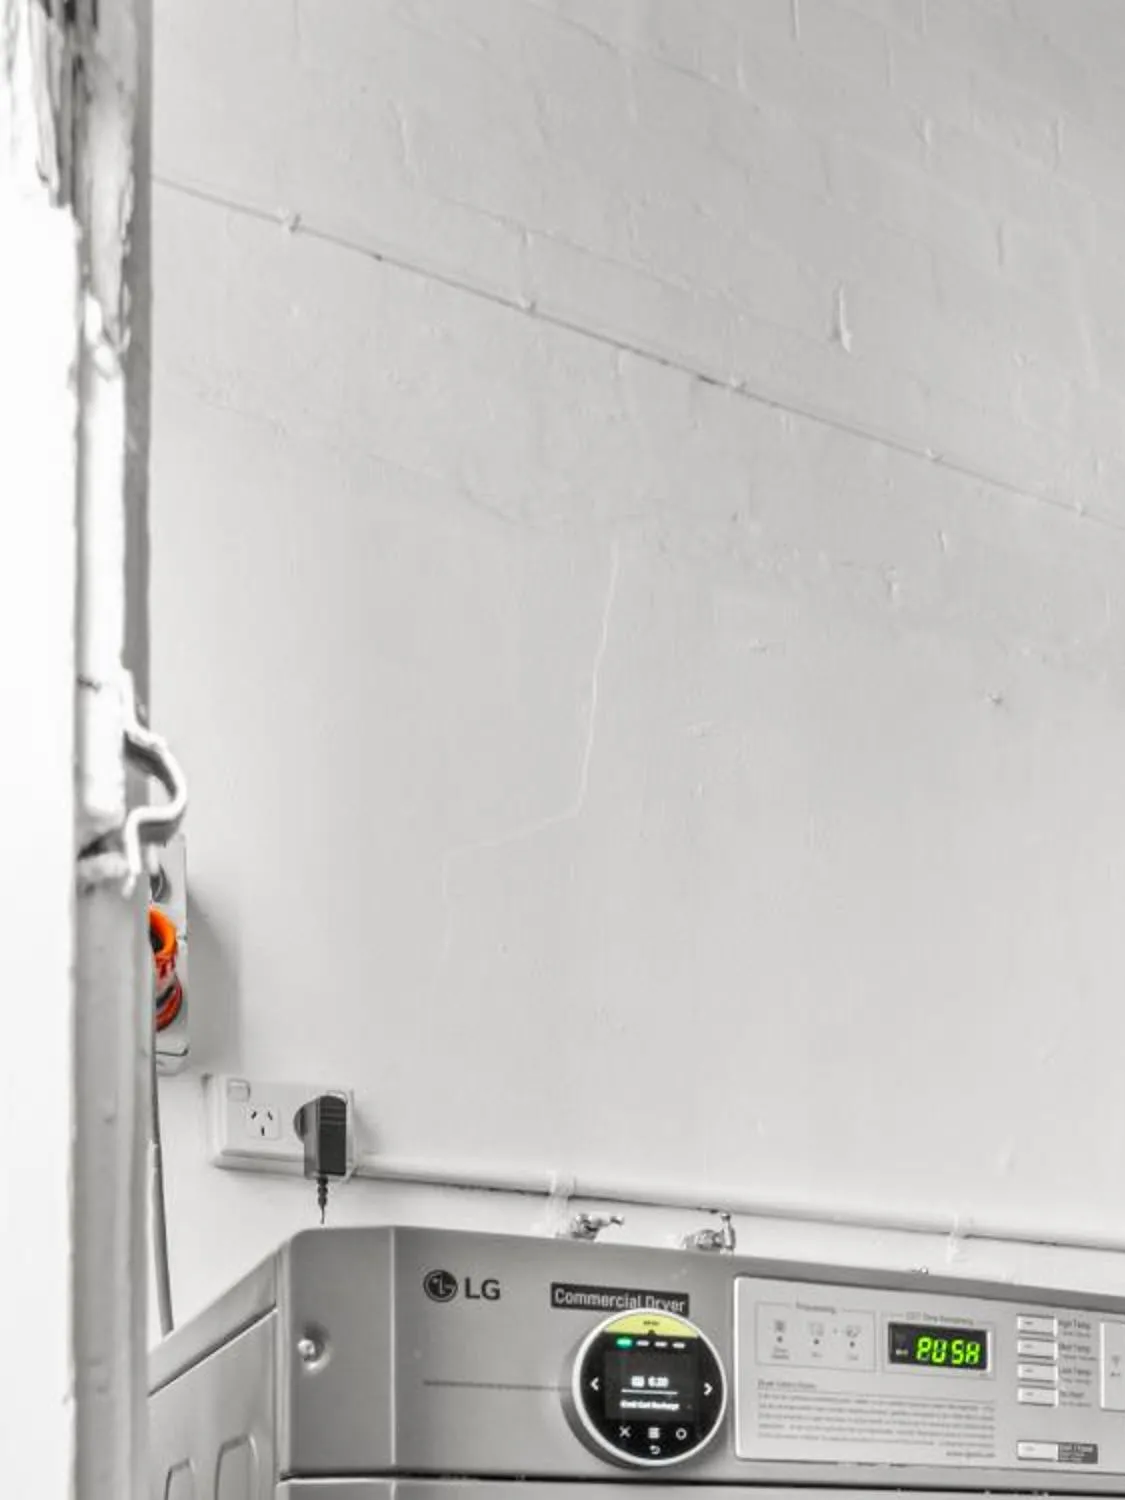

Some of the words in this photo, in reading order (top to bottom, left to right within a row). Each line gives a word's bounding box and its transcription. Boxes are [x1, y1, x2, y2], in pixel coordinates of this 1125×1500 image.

[465, 1278, 501, 1300] LG
[555, 1288, 641, 1309] Commercial
[645, 1295, 685, 1312] Dryer
[916, 1335, 980, 1365] PUSH
